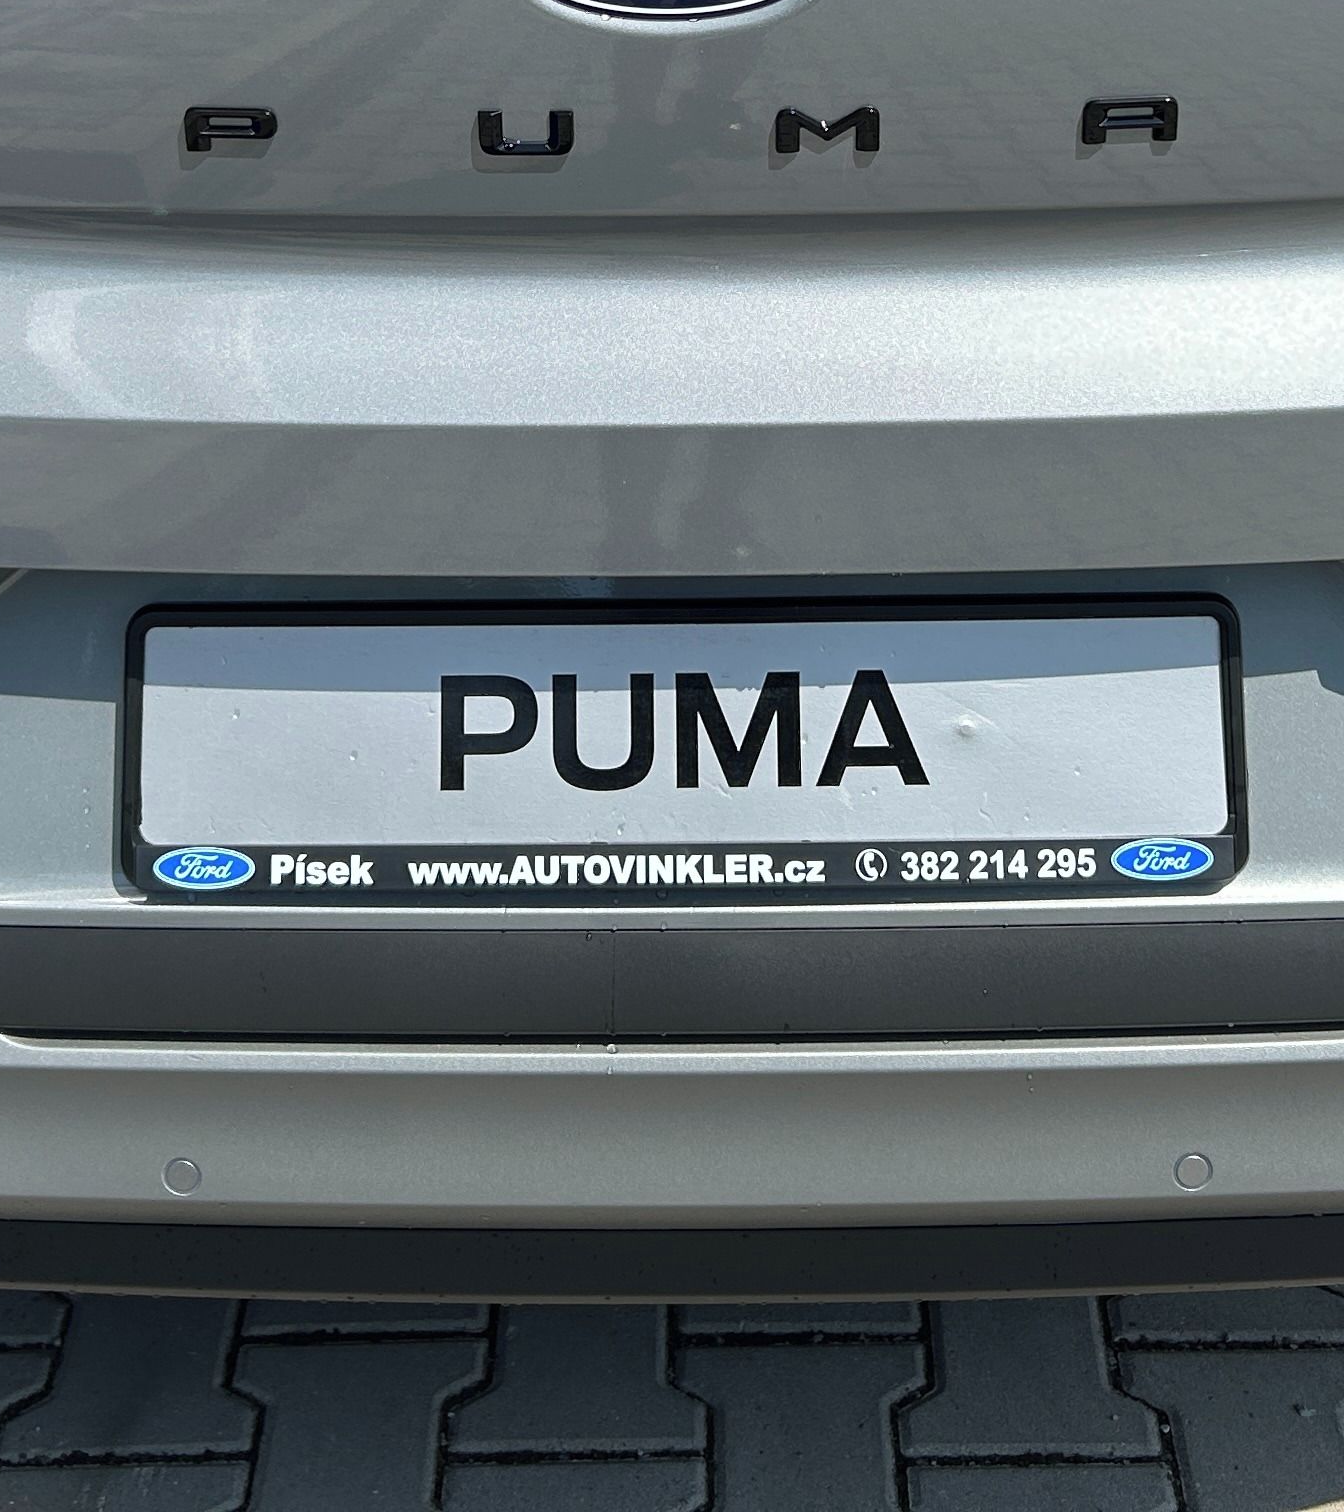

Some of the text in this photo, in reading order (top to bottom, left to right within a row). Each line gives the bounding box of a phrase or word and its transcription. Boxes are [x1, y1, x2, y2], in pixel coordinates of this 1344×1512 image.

[184, 94, 1180, 156] PUMA
[440, 669, 930, 791] PUMA
[271, 854, 375, 886] Písek
[408, 853, 826, 886] www.AUTOVINKLER.cz
[900, 851, 959, 882] 382
[969, 850, 1029, 881] 214
[1037, 848, 1097, 879] 295
